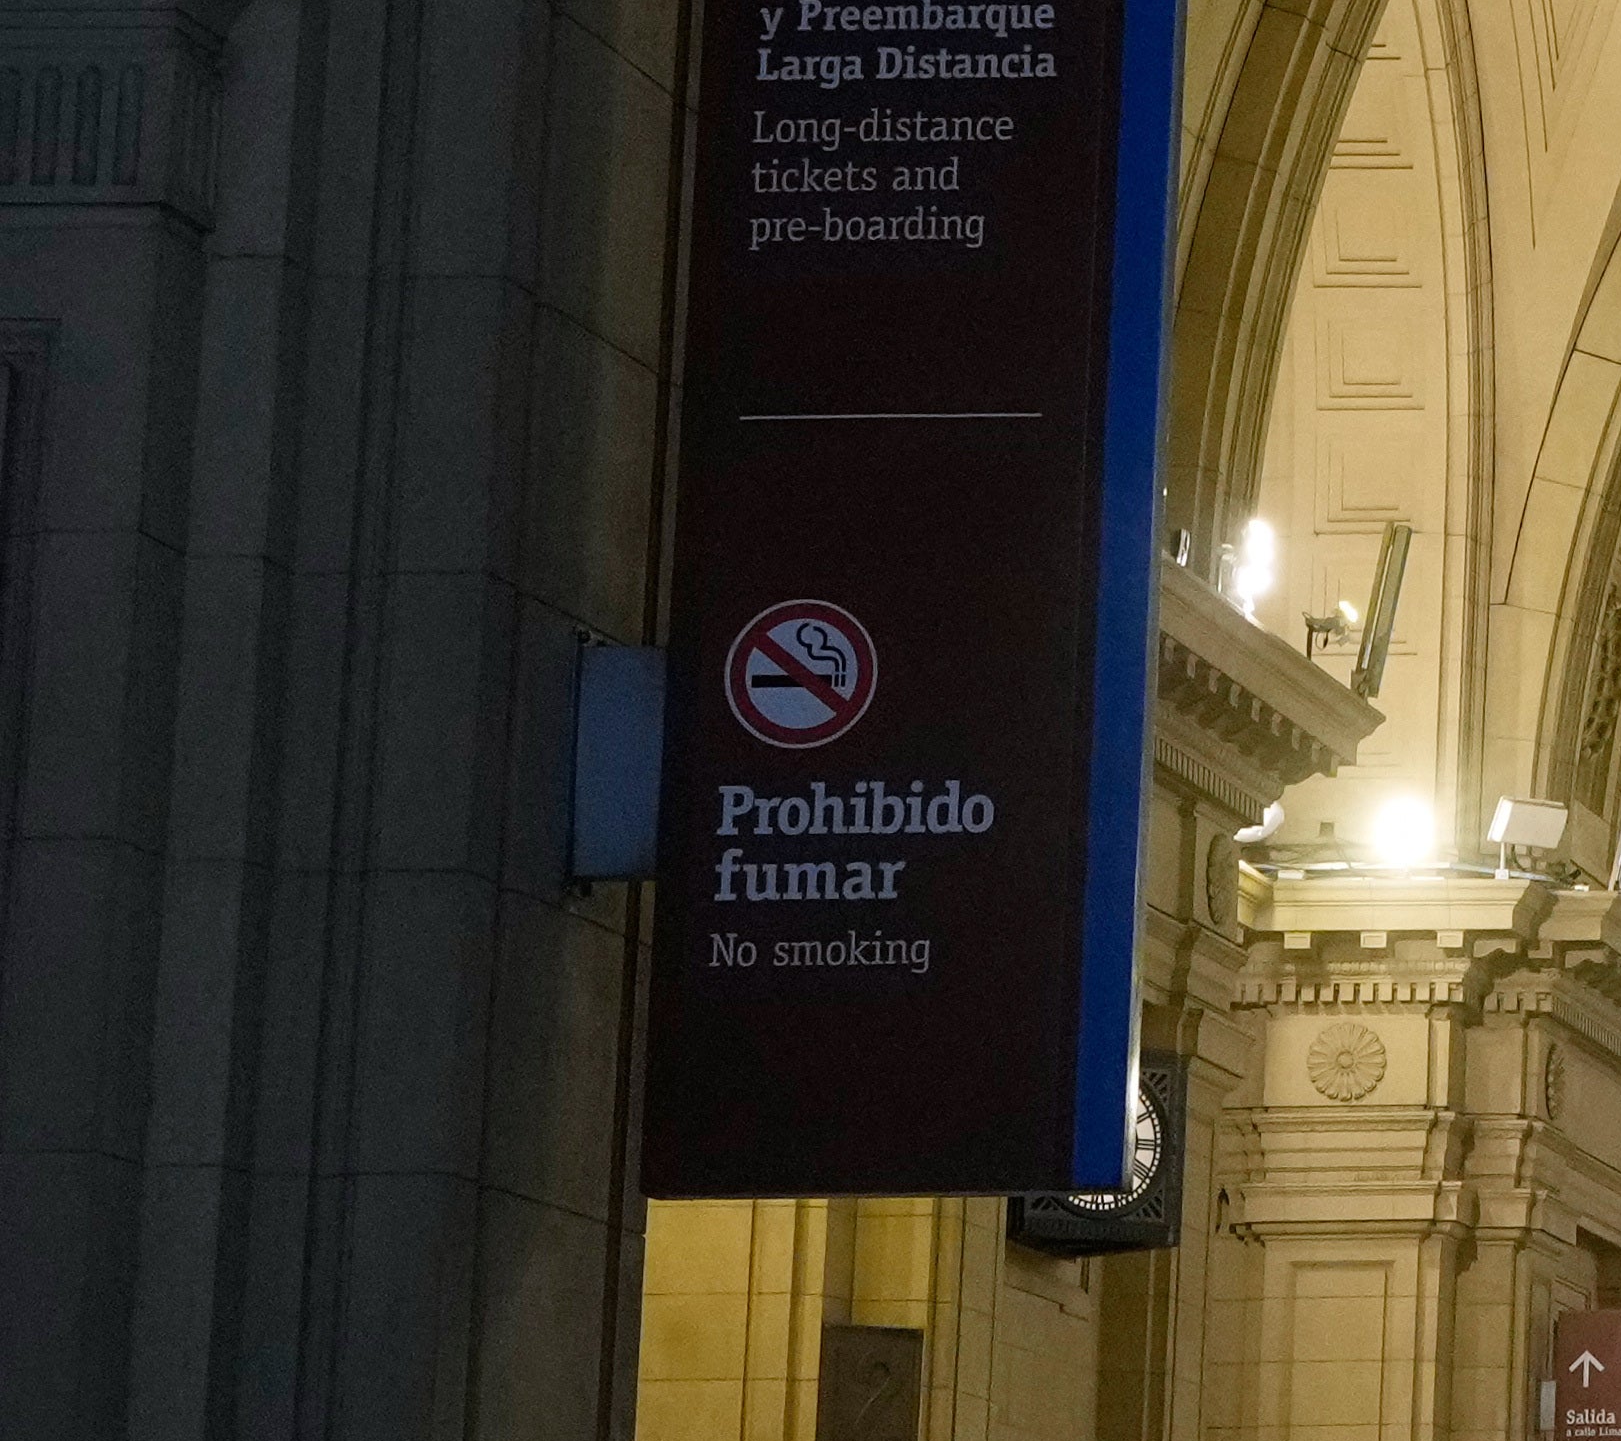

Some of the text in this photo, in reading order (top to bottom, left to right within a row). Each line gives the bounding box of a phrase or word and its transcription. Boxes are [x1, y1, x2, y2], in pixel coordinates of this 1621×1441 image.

[760, 8, 783, 40] y
[757, 45, 1057, 89] Larga Distancia
[753, 108, 1014, 151] Long-distance
[752, 156, 959, 192] tickets and
[749, 206, 984, 250] pre-boarding
[717, 780, 994, 835] Prohibido
[714, 848, 906, 901] fumar
[709, 930, 930, 973] No smoking
[1566, 1409, 1617, 1425] Salida
[1566, 1429, 1572, 1437] a
[1574, 1427, 1596, 1438] calle
